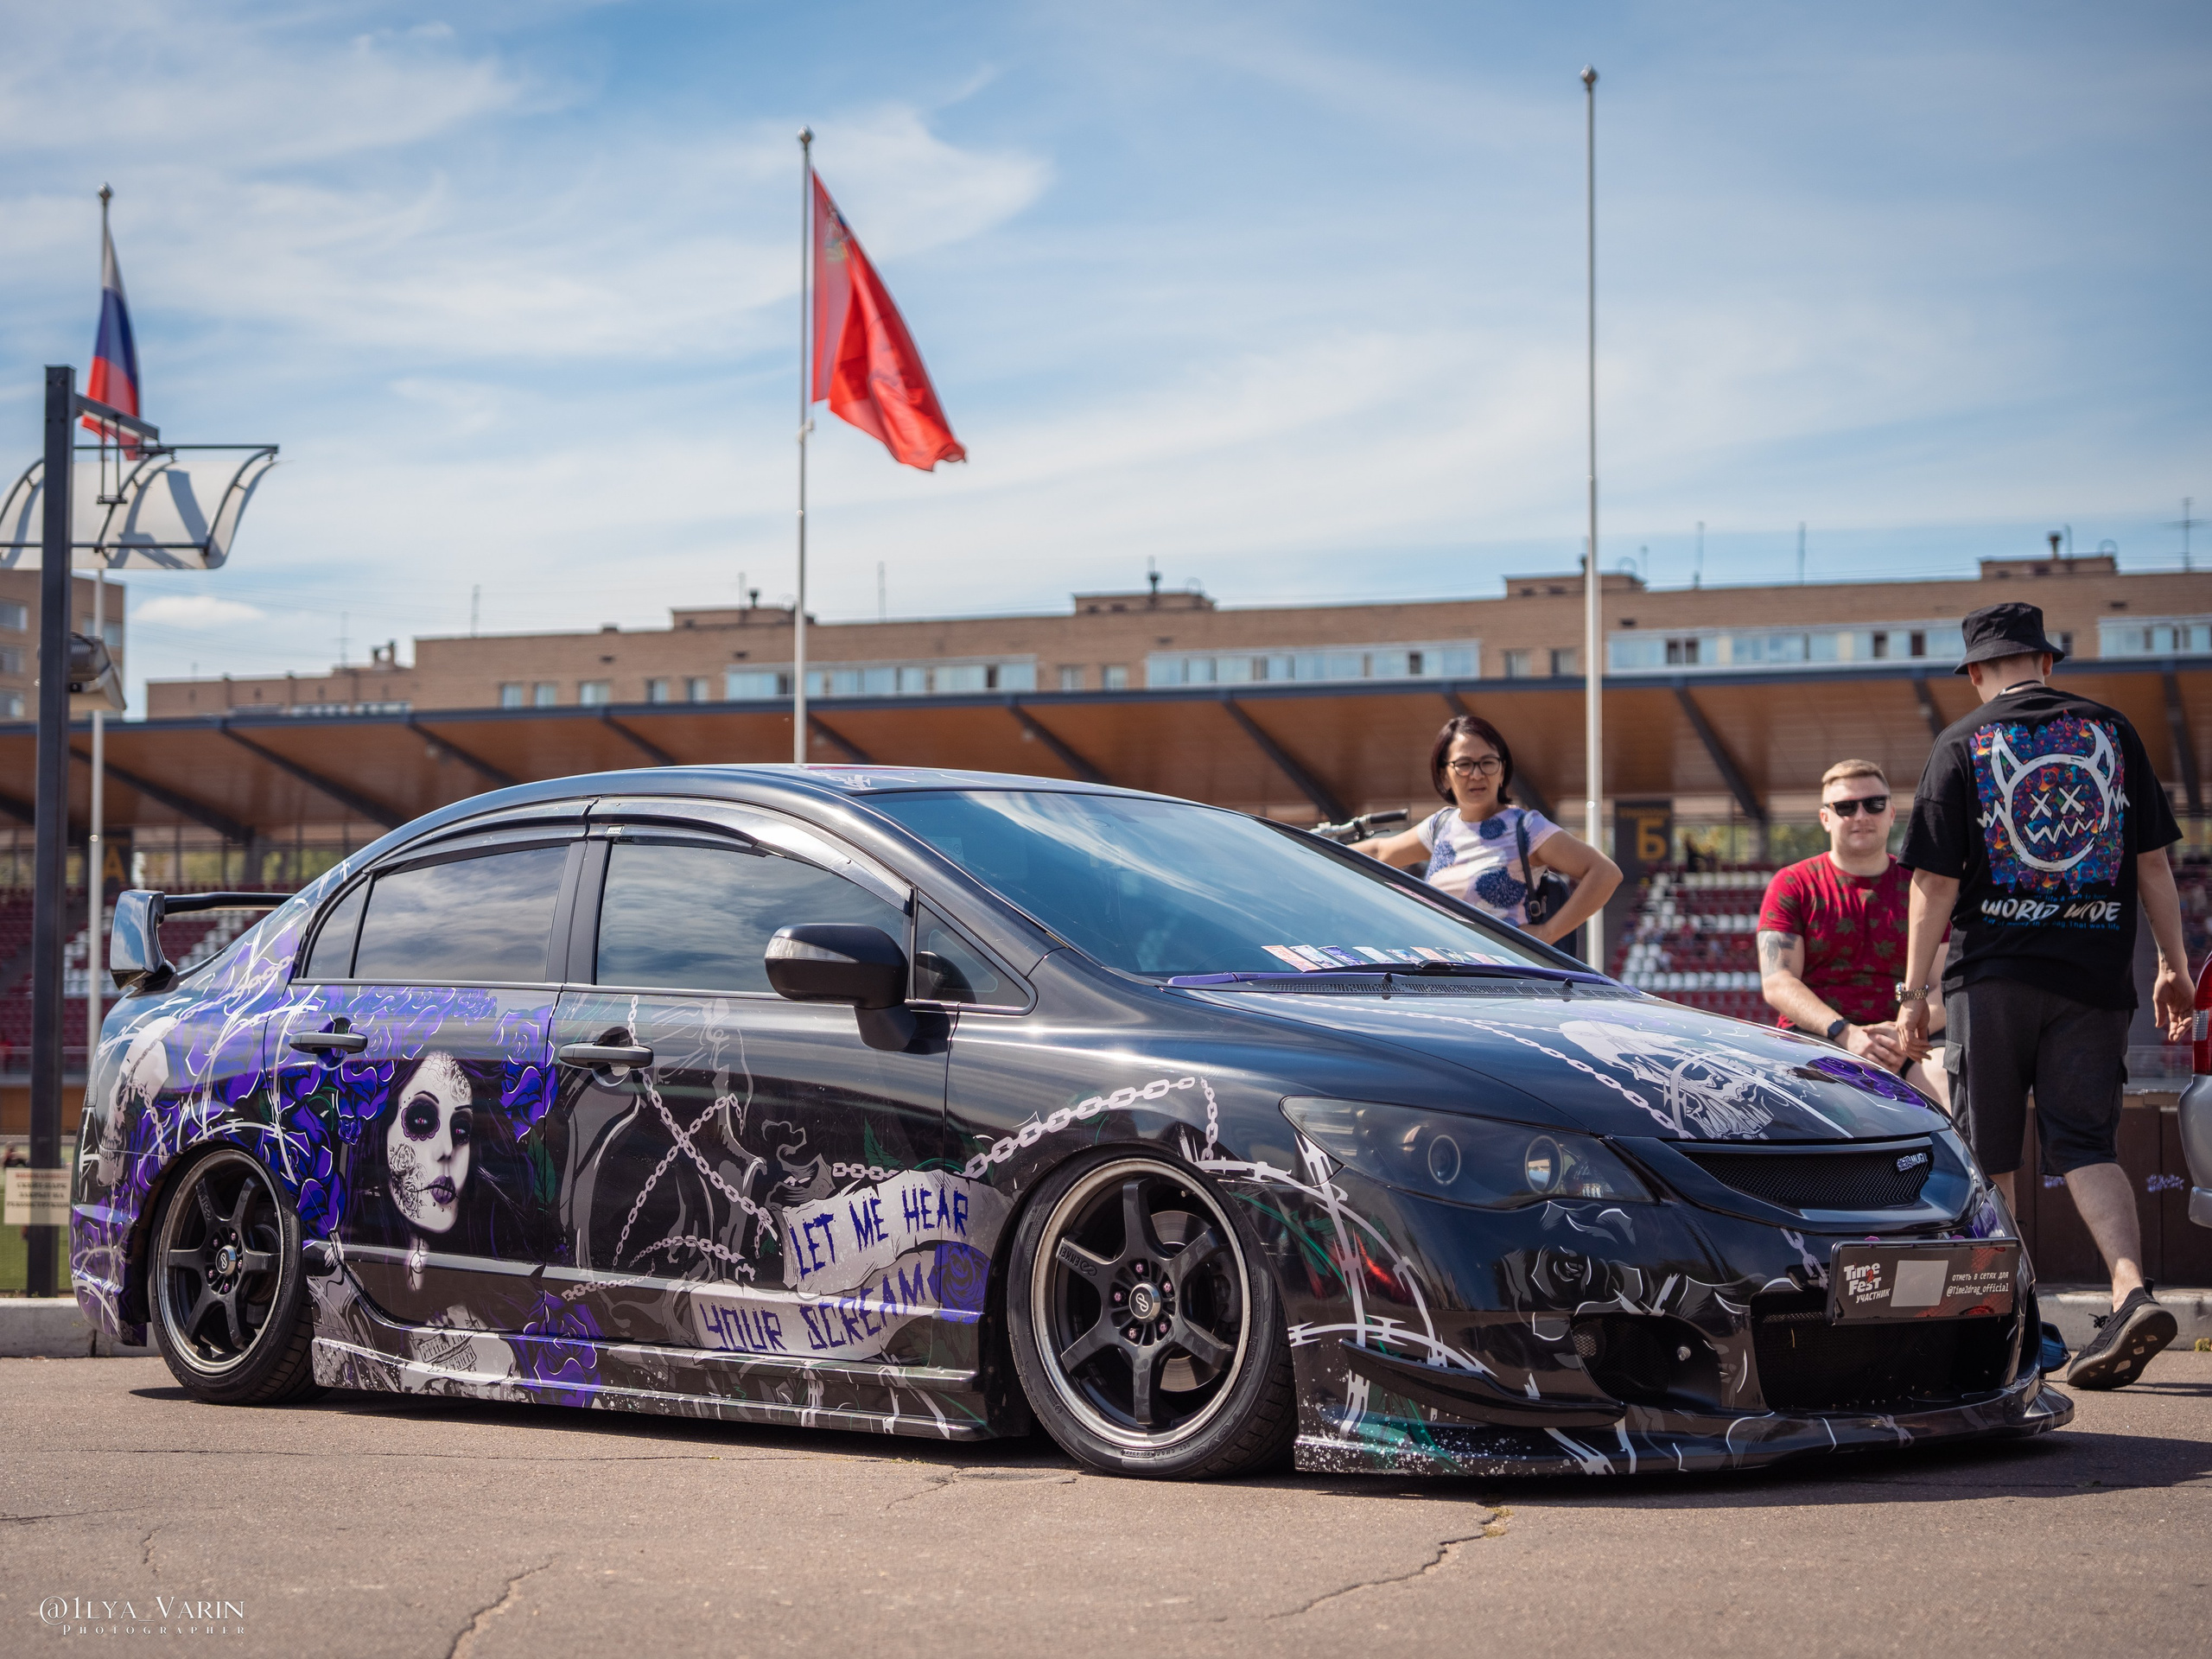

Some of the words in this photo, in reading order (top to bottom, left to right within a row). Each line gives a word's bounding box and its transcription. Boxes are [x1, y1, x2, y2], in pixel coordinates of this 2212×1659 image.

[1637, 817, 1667, 861] Б
[1981, 899, 2060, 922] WORLD
[2063, 900, 2121, 923] WIDE
[789, 1213, 836, 1281] LET
[848, 1193, 889, 1253] ME
[901, 1183, 969, 1238] HEAR
[1843, 1262, 1881, 1281] Time
[1866, 1269, 1874, 1283] 2
[699, 1302, 787, 1351] YOUR
[798, 1261, 927, 1351] SCREAM
[1856, 1288, 1891, 1304] УЧАСТНИК
